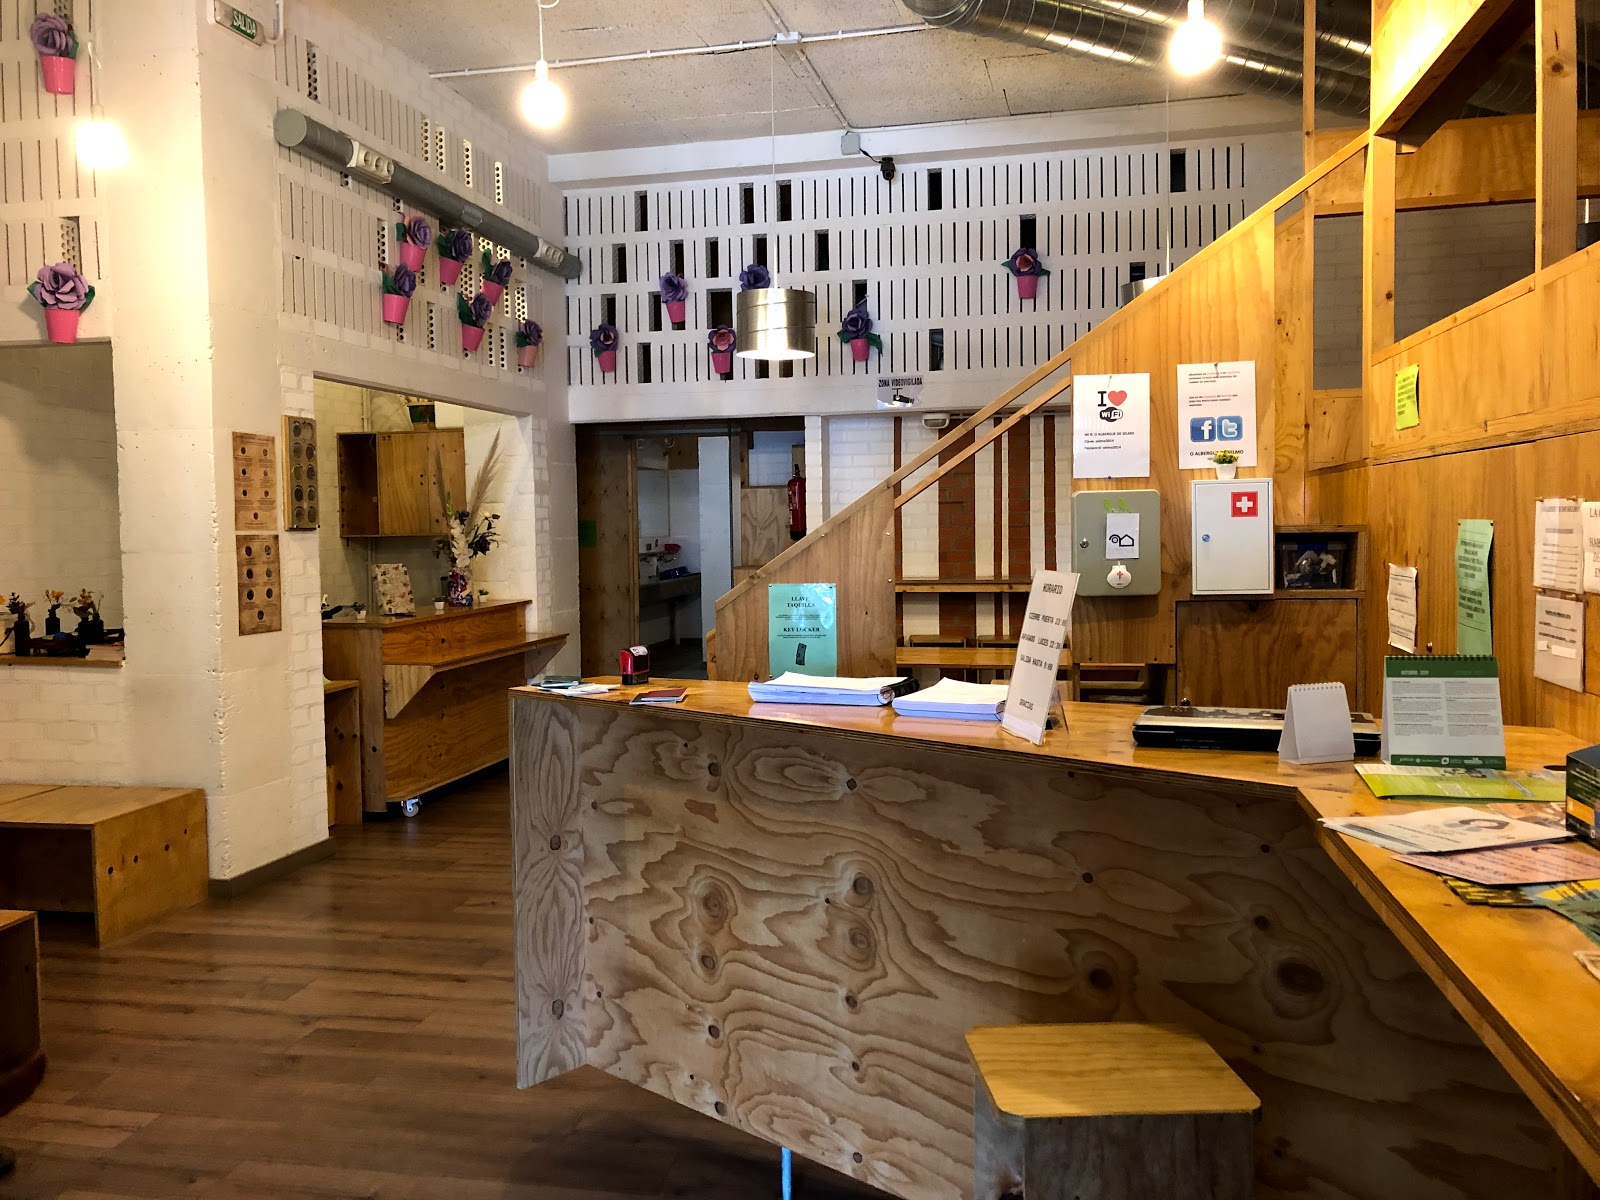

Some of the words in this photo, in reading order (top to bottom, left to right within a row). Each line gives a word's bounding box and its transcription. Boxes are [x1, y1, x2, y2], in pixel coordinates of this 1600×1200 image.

[233, 10, 256, 37] SALIDA
[878, 379, 890, 387] ZONA
[1098, 390, 1106, 406] I
[1042, 583, 1063, 594] HORARIO
[1041, 614, 1054, 622] PUERTA
[1022, 633, 1035, 642] APAGADO
[1038, 638, 1049, 646] LUCES
[1020, 654, 1032, 663] SALIDA
[1032, 658, 1043, 667] HASTA
[1019, 698, 1034, 710] GRACIAS
